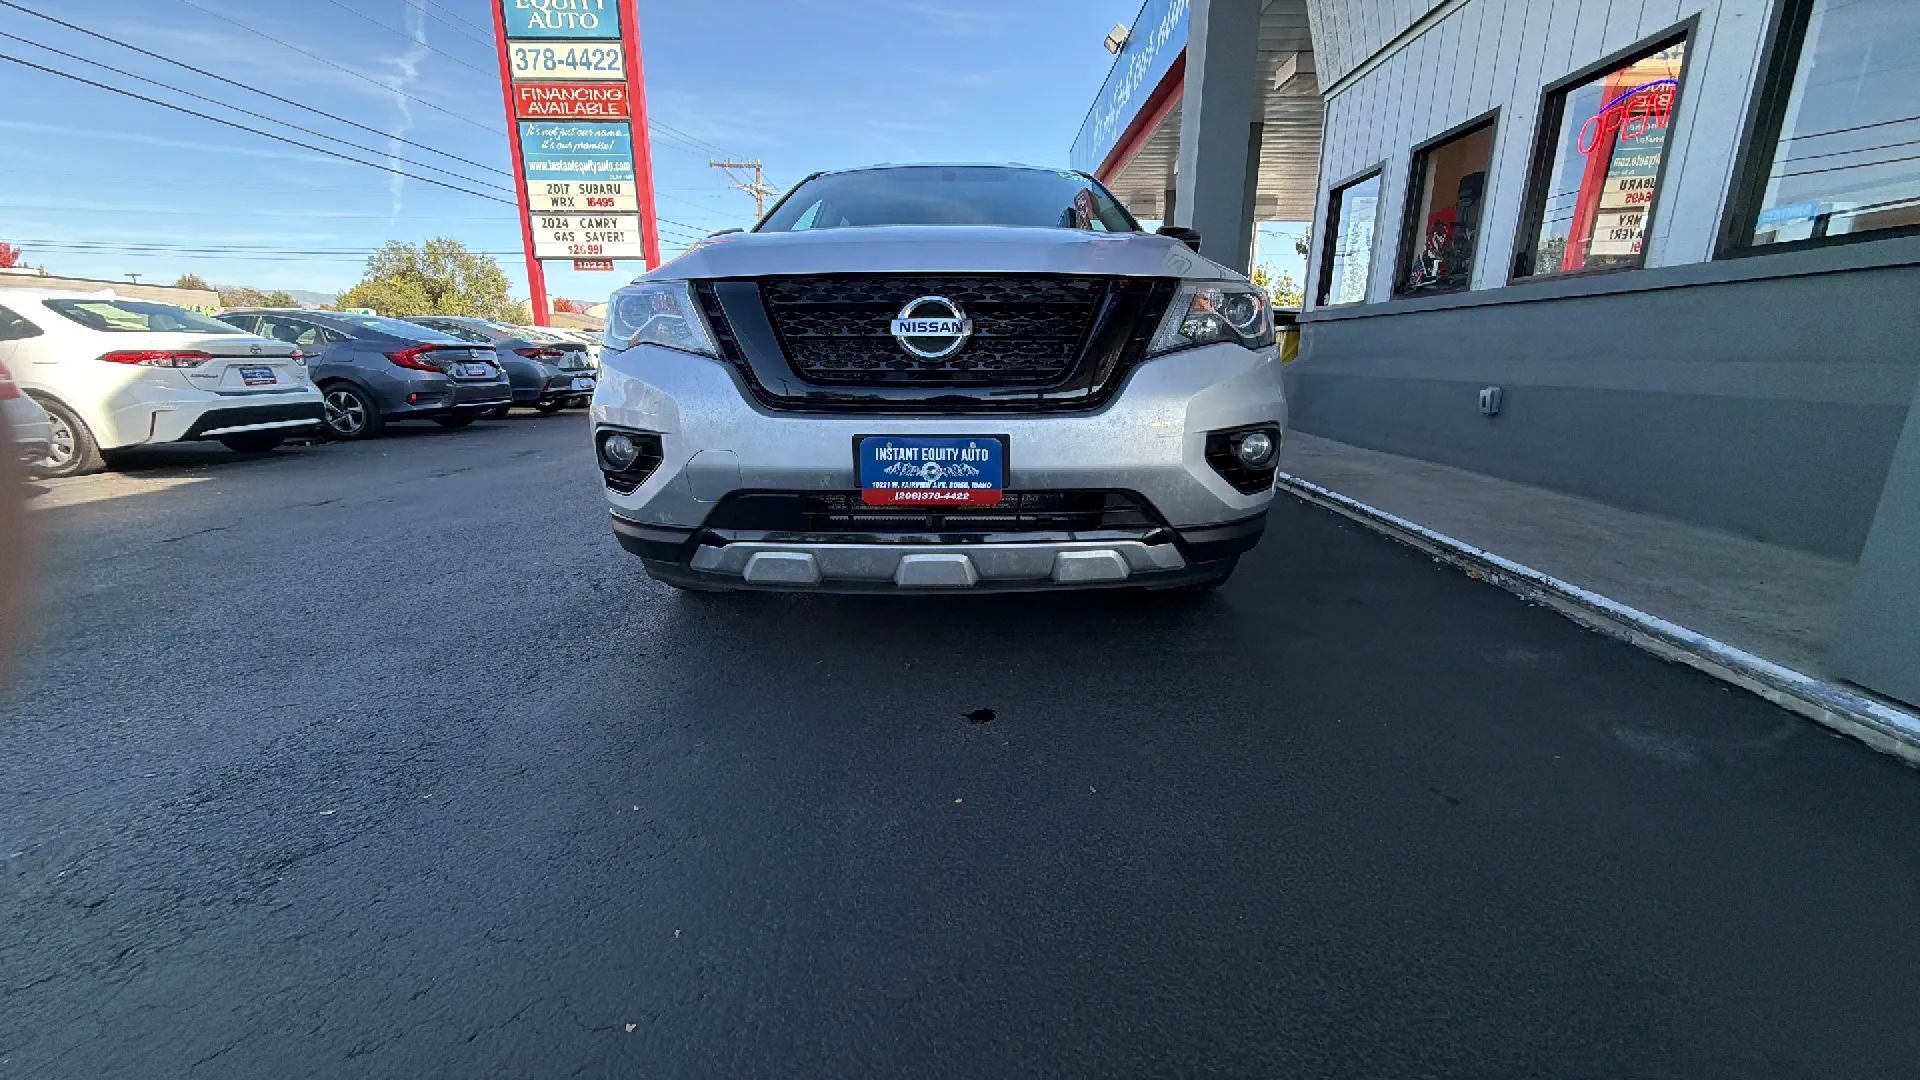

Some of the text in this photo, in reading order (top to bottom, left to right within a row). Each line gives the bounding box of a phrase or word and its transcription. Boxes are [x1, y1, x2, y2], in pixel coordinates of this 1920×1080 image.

[528, 11, 599, 29] AUTO
[515, 48, 621, 71] 378-4422
[521, 87, 623, 101] FINANCING
[527, 102, 621, 115] AVAILABLE
[1577, 87, 1677, 154] OPEN
[526, 123, 540, 137] It's
[542, 126, 559, 137] not
[557, 127, 577, 141] just
[576, 129, 593, 137] our
[556, 141, 573, 150] our
[572, 139, 615, 153] promise!
[547, 183, 621, 195] 2017 SUBARU
[551, 196, 615, 207] WRX 16495
[541, 217, 618, 228] 2024 CAMRY
[554, 231, 625, 242] GAS SAVER!
[899, 321, 963, 333] NISSAN
[875, 447, 989, 462] INSTANT EQUITY AUTO
